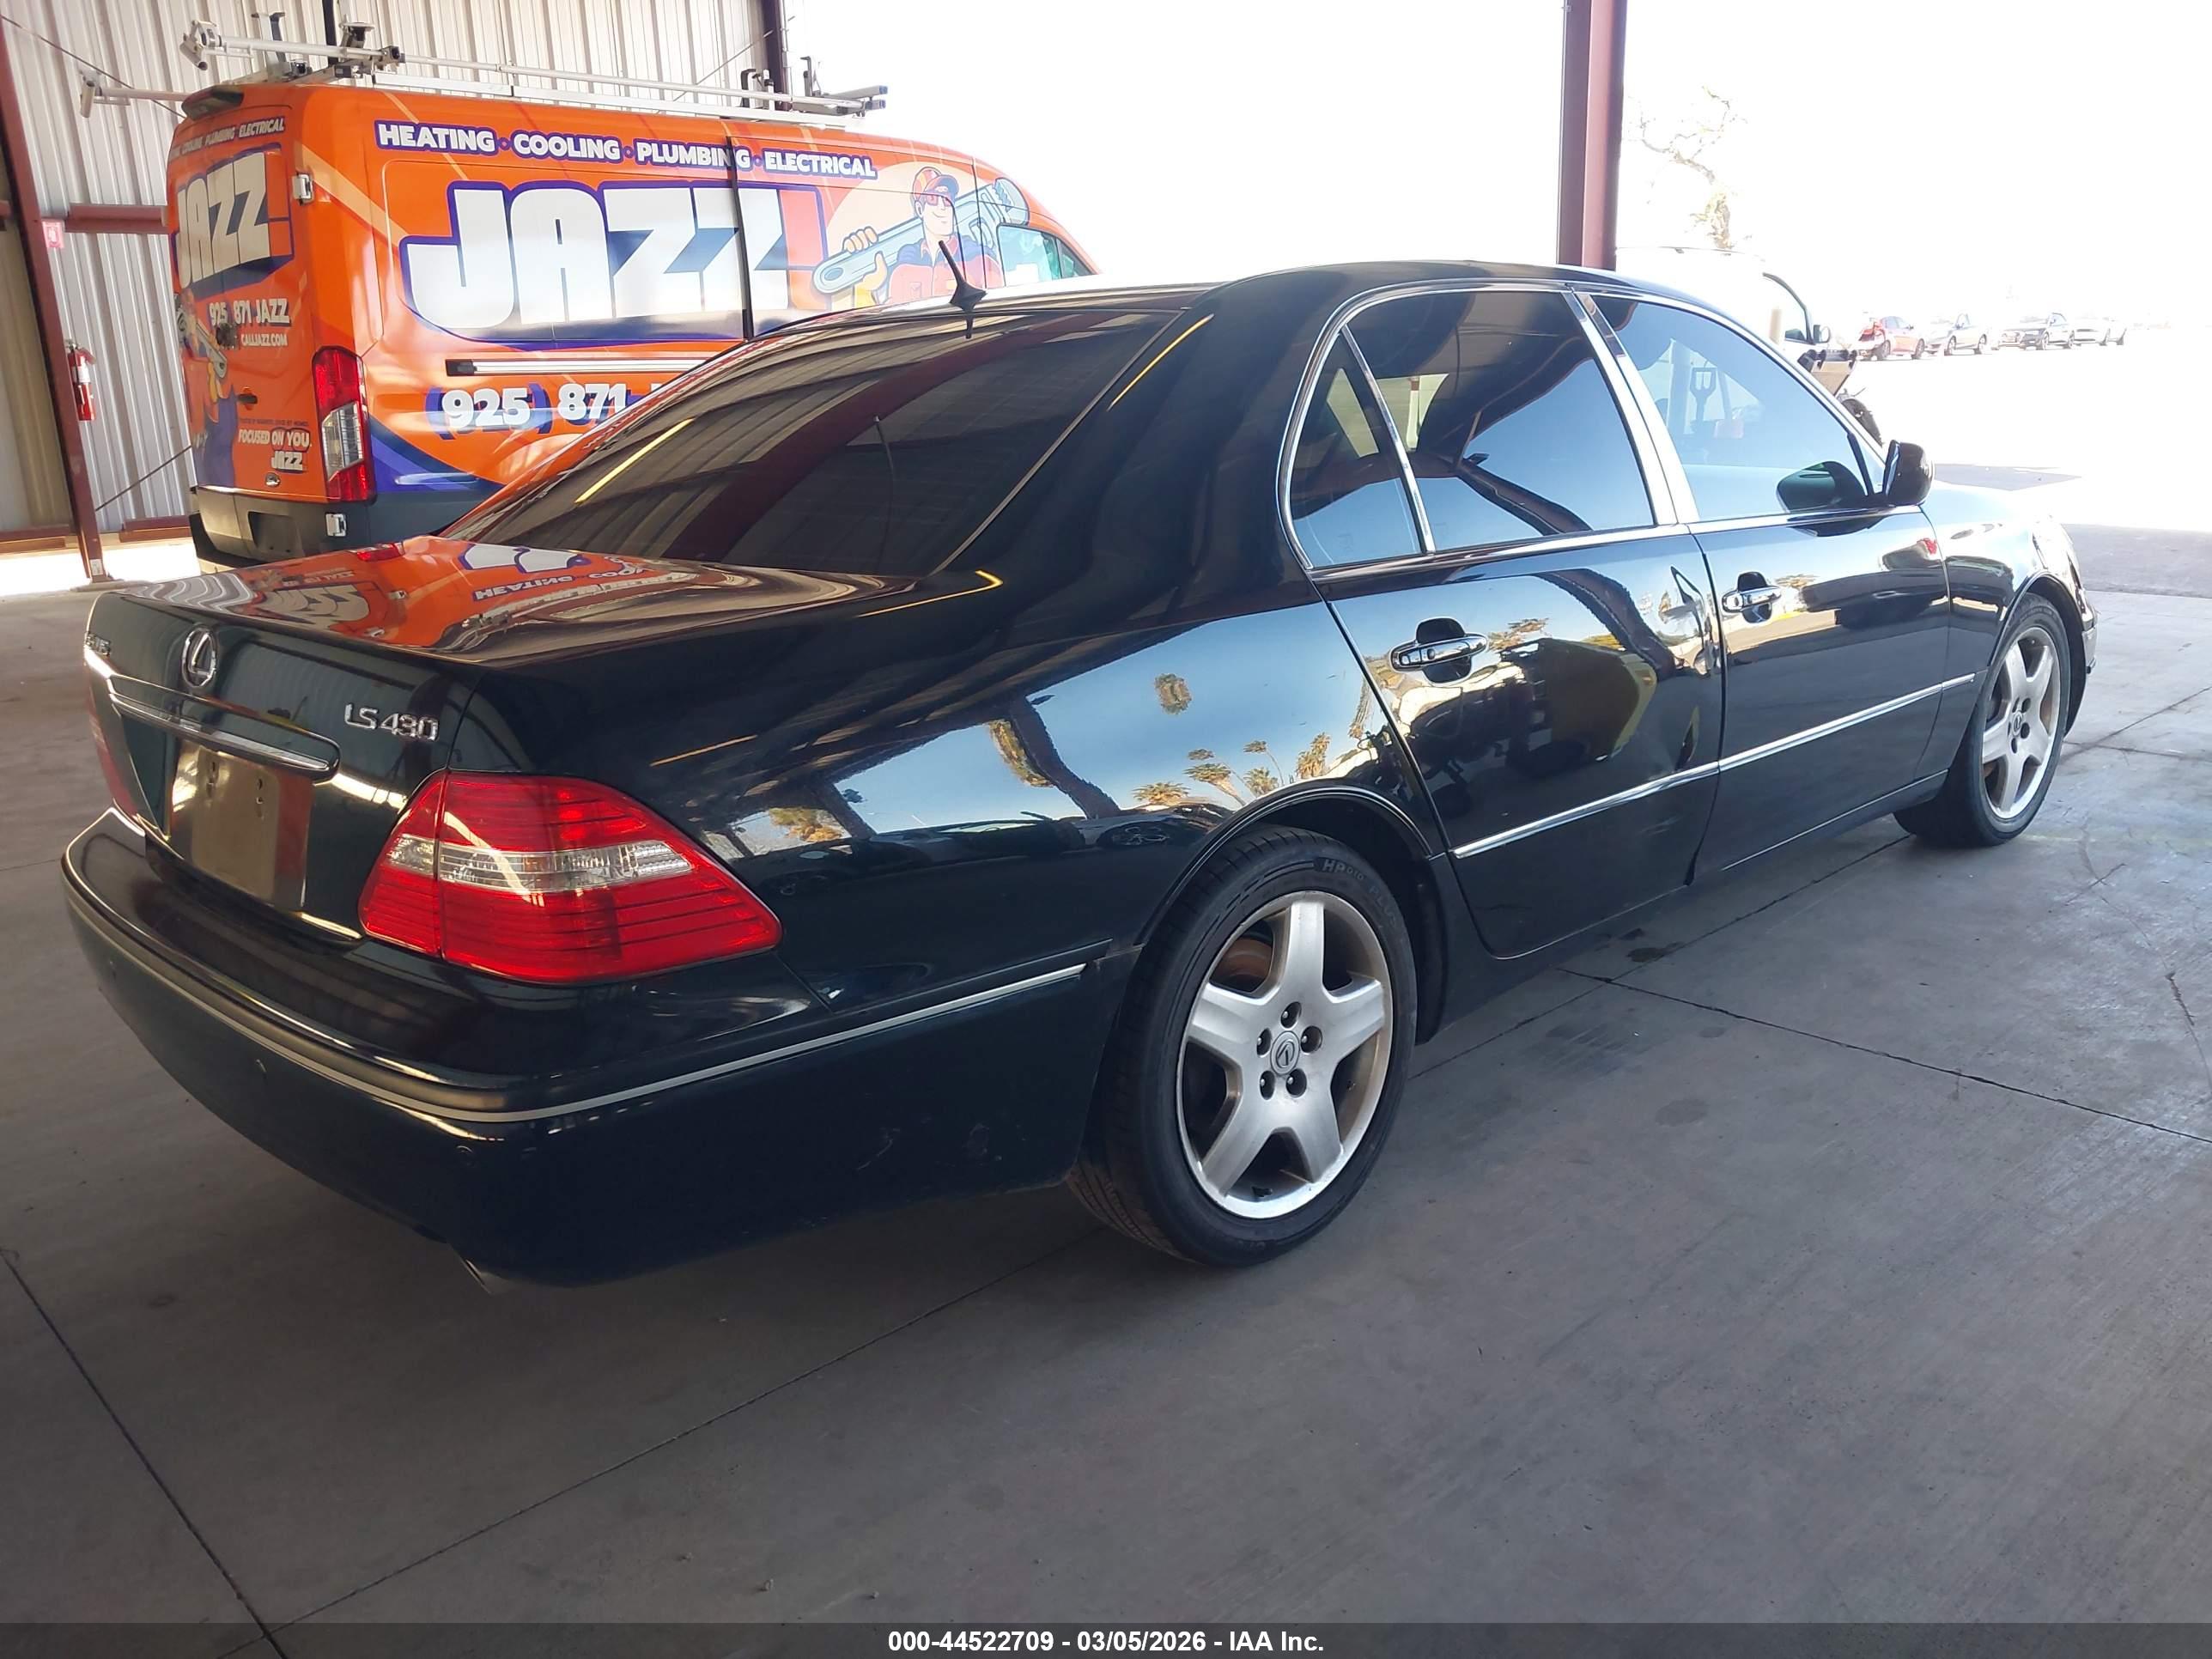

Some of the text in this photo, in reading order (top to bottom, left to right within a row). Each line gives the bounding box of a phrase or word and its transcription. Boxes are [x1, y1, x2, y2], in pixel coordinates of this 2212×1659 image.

[239, 118, 285, 138] ELECTRICAL
[378, 124, 877, 178] HEATING COOLING PLUMBING ELECTRICAL
[175, 152, 270, 289] JAZZ
[405, 187, 788, 329] JAZZ
[233, 300, 252, 325] 871
[255, 297, 290, 324] JAZZ
[240, 331, 289, 347] CALLJAZZ.COM
[558, 383, 627, 421] 871
[238, 428, 270, 445] FOCUSED
[271, 430, 285, 446] ON
[270, 450, 303, 471] JAZZ
[344, 703, 439, 741] LS 430
